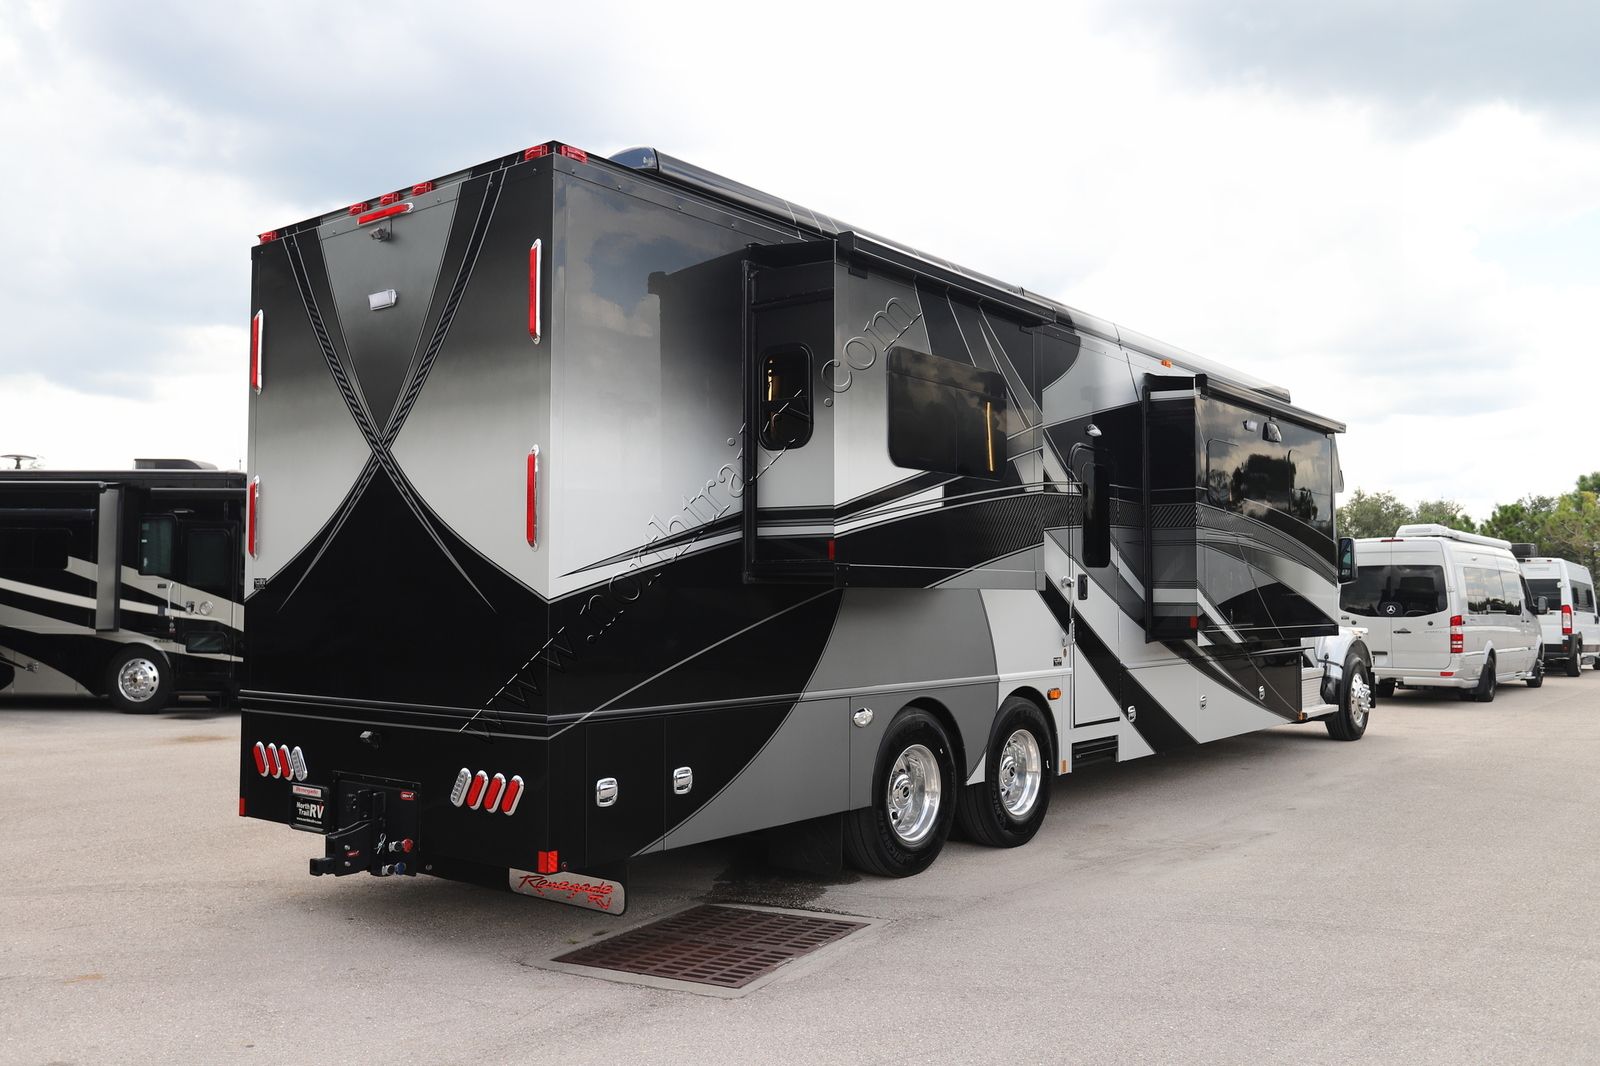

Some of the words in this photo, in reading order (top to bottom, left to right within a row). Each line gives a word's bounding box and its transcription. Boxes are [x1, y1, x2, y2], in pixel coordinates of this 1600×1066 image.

[296, 801, 310, 809] North
[310, 803, 325, 819] RV
[298, 808, 310, 816] Trail
[518, 874, 614, 899] Renegade
